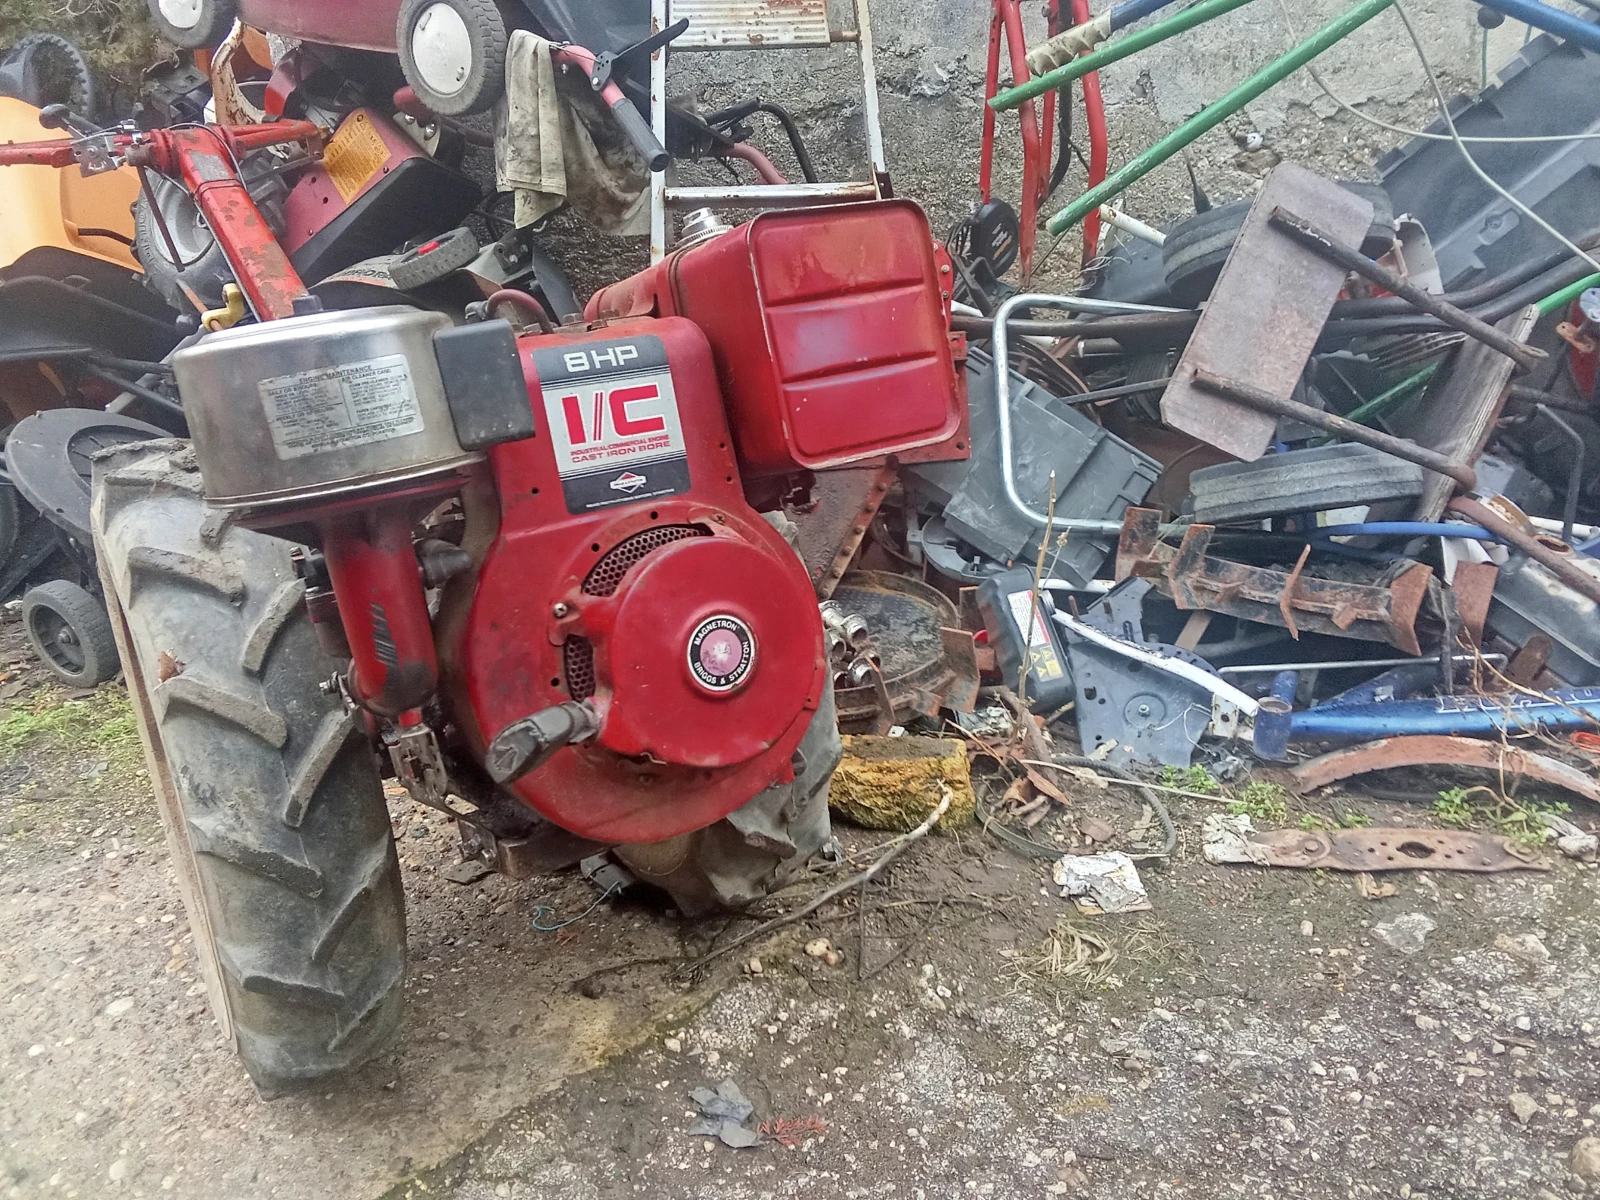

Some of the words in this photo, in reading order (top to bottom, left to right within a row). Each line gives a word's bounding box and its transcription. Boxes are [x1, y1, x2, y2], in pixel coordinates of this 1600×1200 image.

[326, 364, 371, 378] MAINTENANCE
[351, 371, 376, 380] CLEANER
[647, 434, 669, 442] ENGINE
[571, 452, 603, 463] CAST
[607, 446, 635, 457] IRON
[638, 440, 670, 451] BORE
[694, 620, 738, 646] MAGNETRON
[694, 661, 717, 684] BRIGGS
[728, 641, 750, 682] STRATTON
